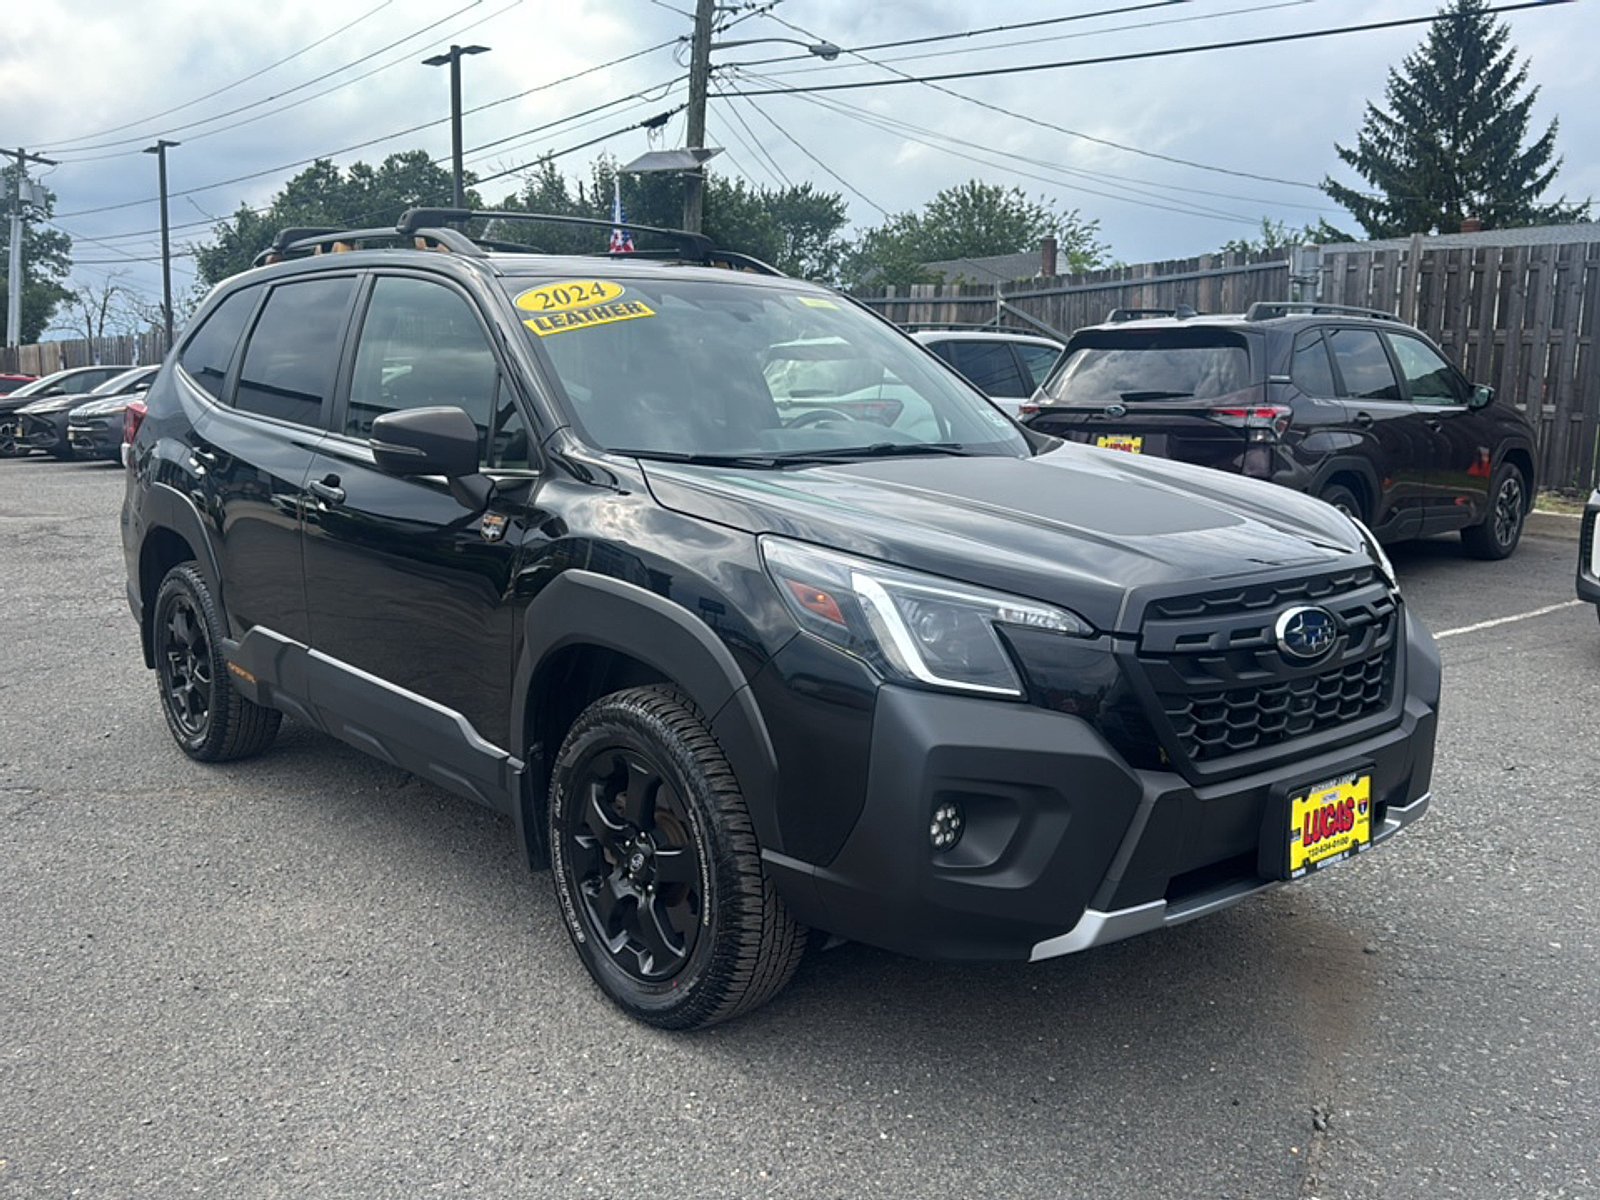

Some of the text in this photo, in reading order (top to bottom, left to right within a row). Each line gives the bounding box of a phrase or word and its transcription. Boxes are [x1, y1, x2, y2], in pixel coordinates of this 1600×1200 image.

[534, 281, 606, 310] 2024
[533, 303, 642, 331] LEATHER
[1303, 797, 1355, 848] LUCAS
